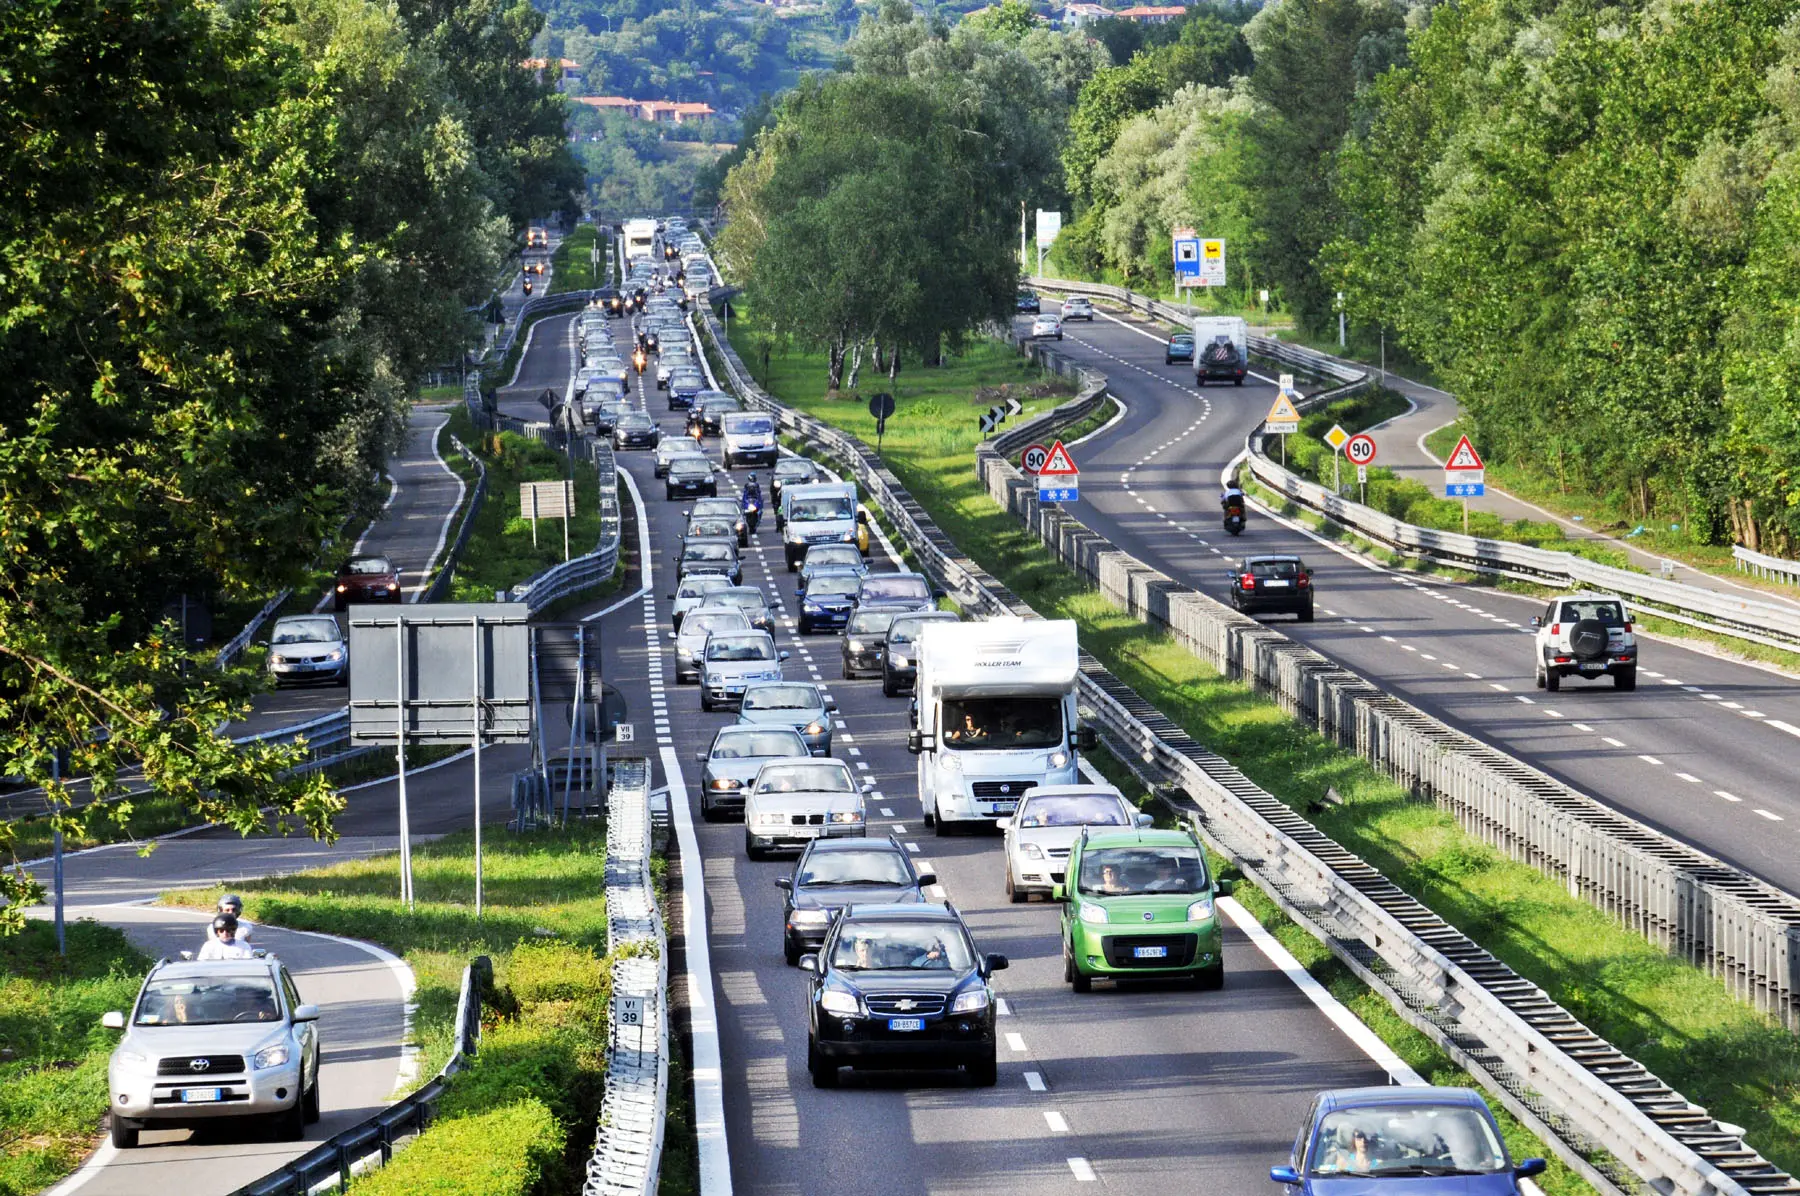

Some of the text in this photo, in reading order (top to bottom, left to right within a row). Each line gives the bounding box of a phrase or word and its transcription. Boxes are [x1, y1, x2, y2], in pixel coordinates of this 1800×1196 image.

[1352, 442, 1370, 457] 90
[1027, 452, 1045, 467] 90
[620, 725, 630, 733] VII
[624, 1000, 635, 1009] VI
[621, 1012, 638, 1023] 39
